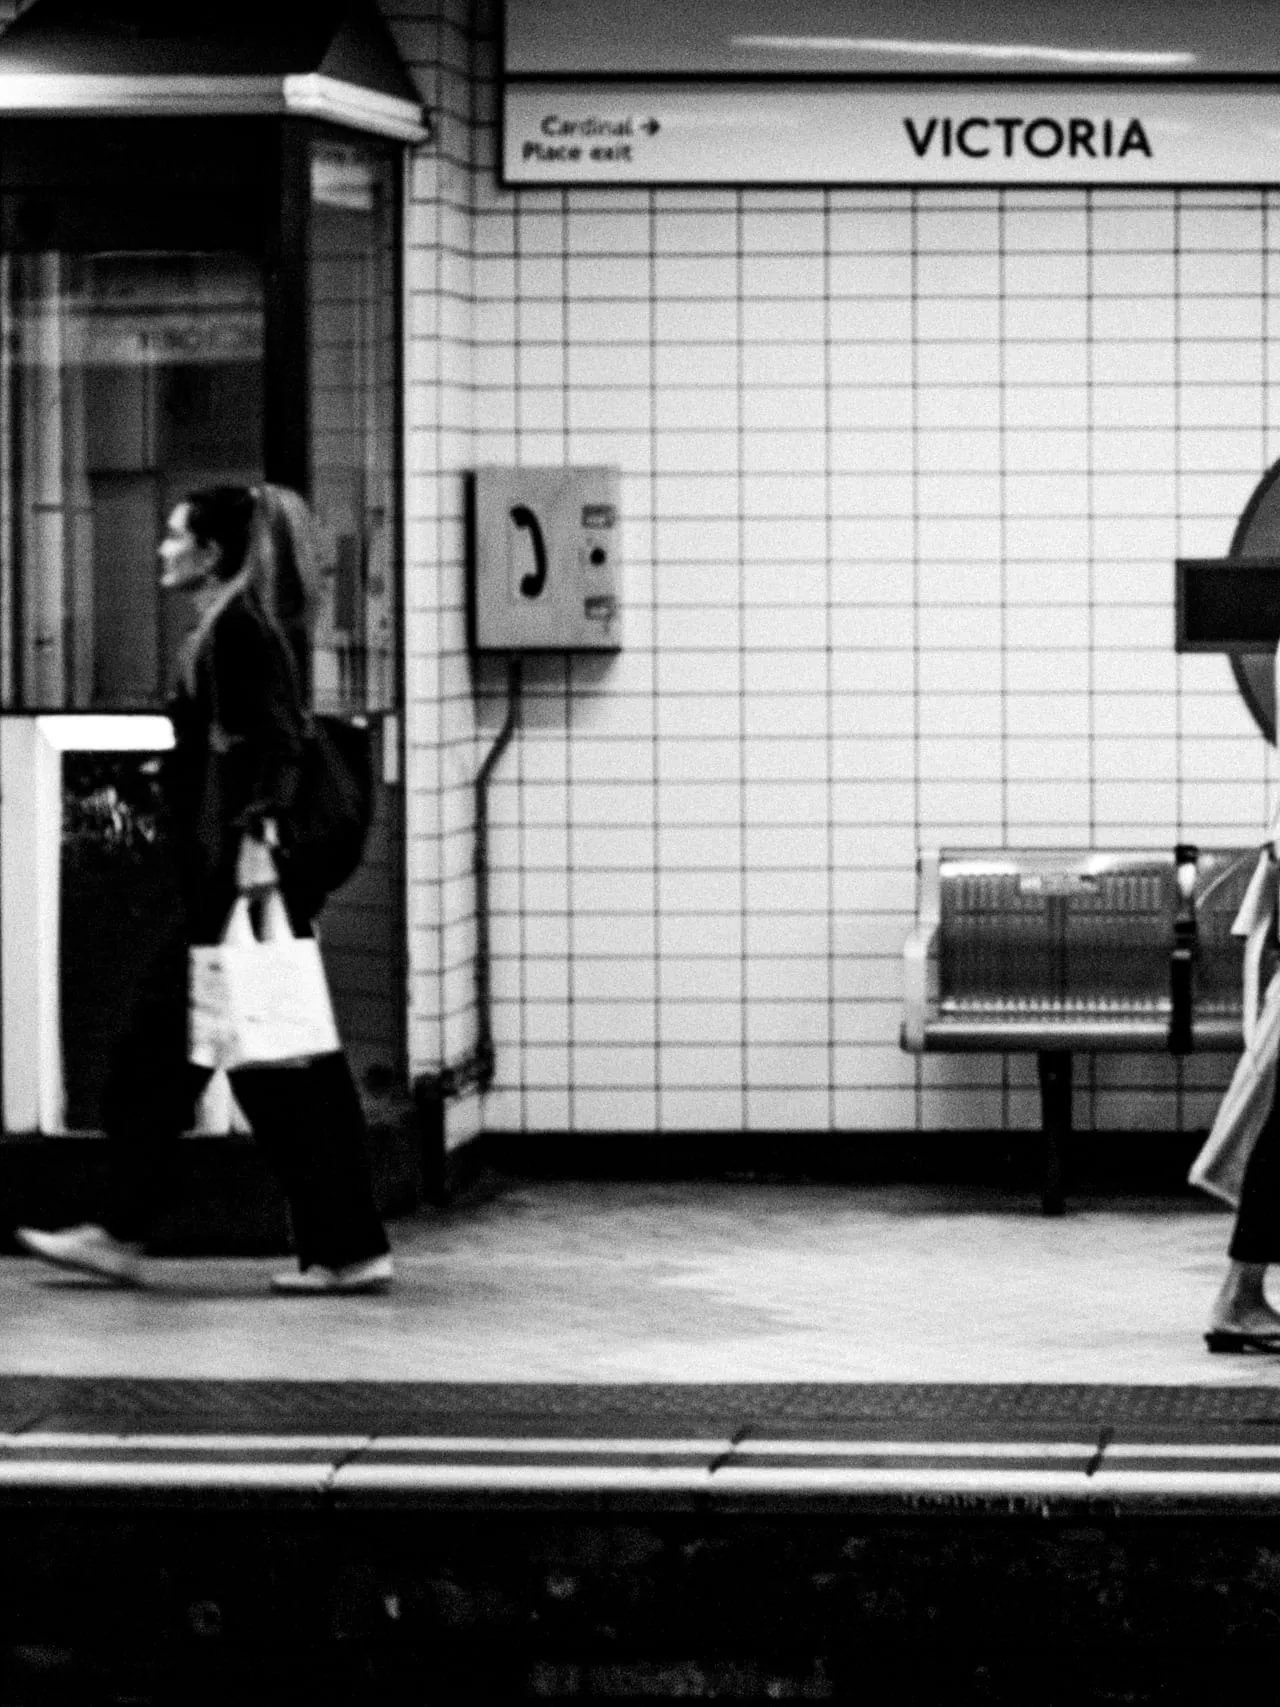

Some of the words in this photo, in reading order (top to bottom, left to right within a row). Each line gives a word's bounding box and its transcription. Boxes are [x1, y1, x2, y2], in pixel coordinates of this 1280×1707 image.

[541, 113, 633, 137] Cardinal
[903, 117, 1153, 158] VICTORIA
[522, 140, 582, 162] Place
[589, 143, 634, 162] exit
